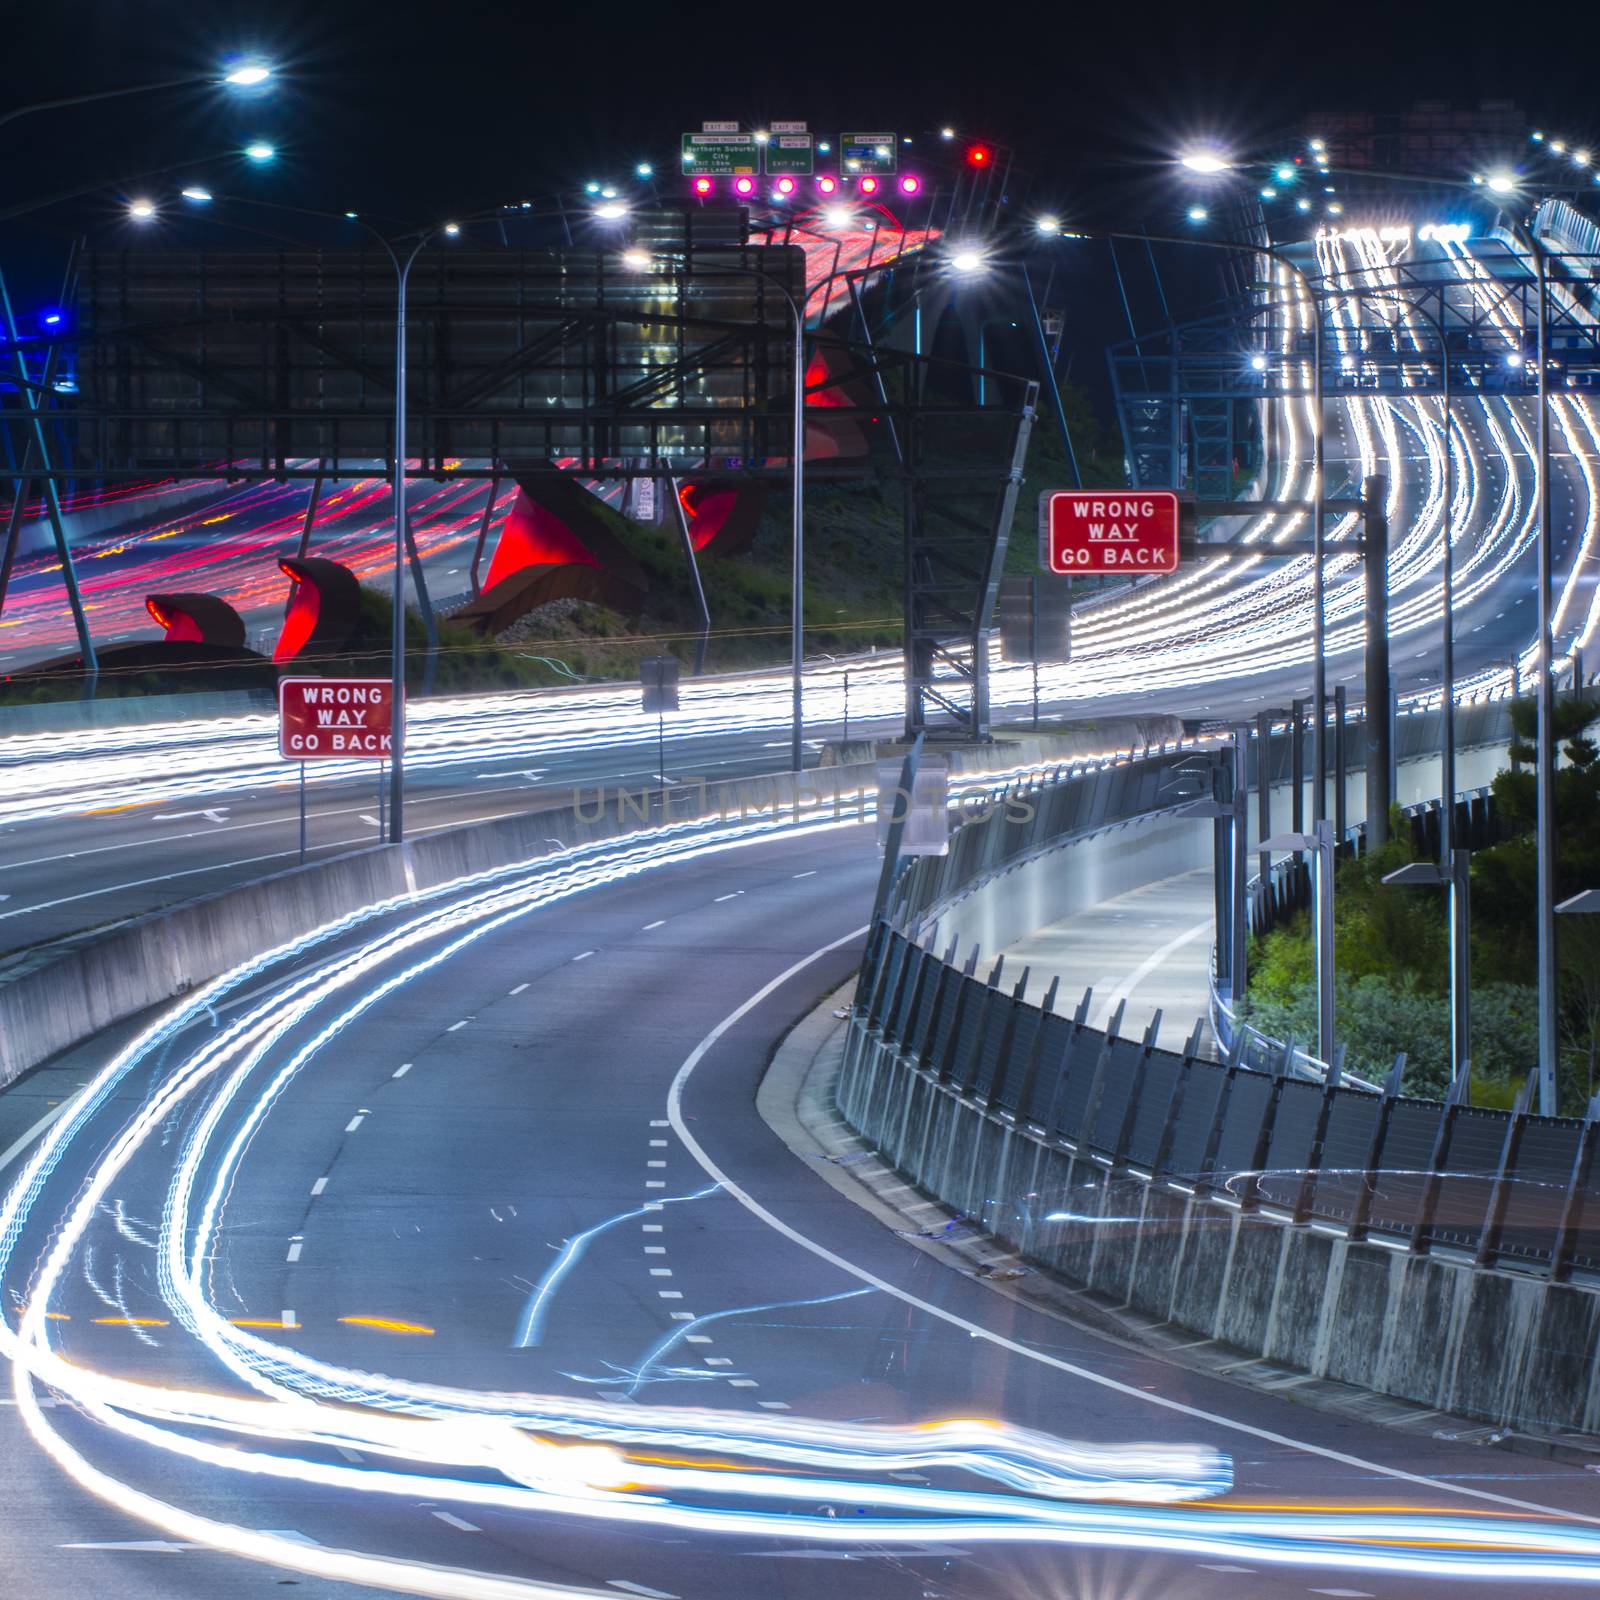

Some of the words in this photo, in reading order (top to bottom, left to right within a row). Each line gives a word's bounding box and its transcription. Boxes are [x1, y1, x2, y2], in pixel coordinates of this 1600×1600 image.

[1073, 501, 1154, 518] WRONG
[1088, 523, 1139, 539] WAY
[1061, 548, 1090, 565] GO
[1104, 548, 1166, 564] BACK
[302, 687, 383, 704] WRONG
[317, 709, 367, 725] WAY
[291, 734, 319, 750] GO
[332, 734, 392, 750] BACK
